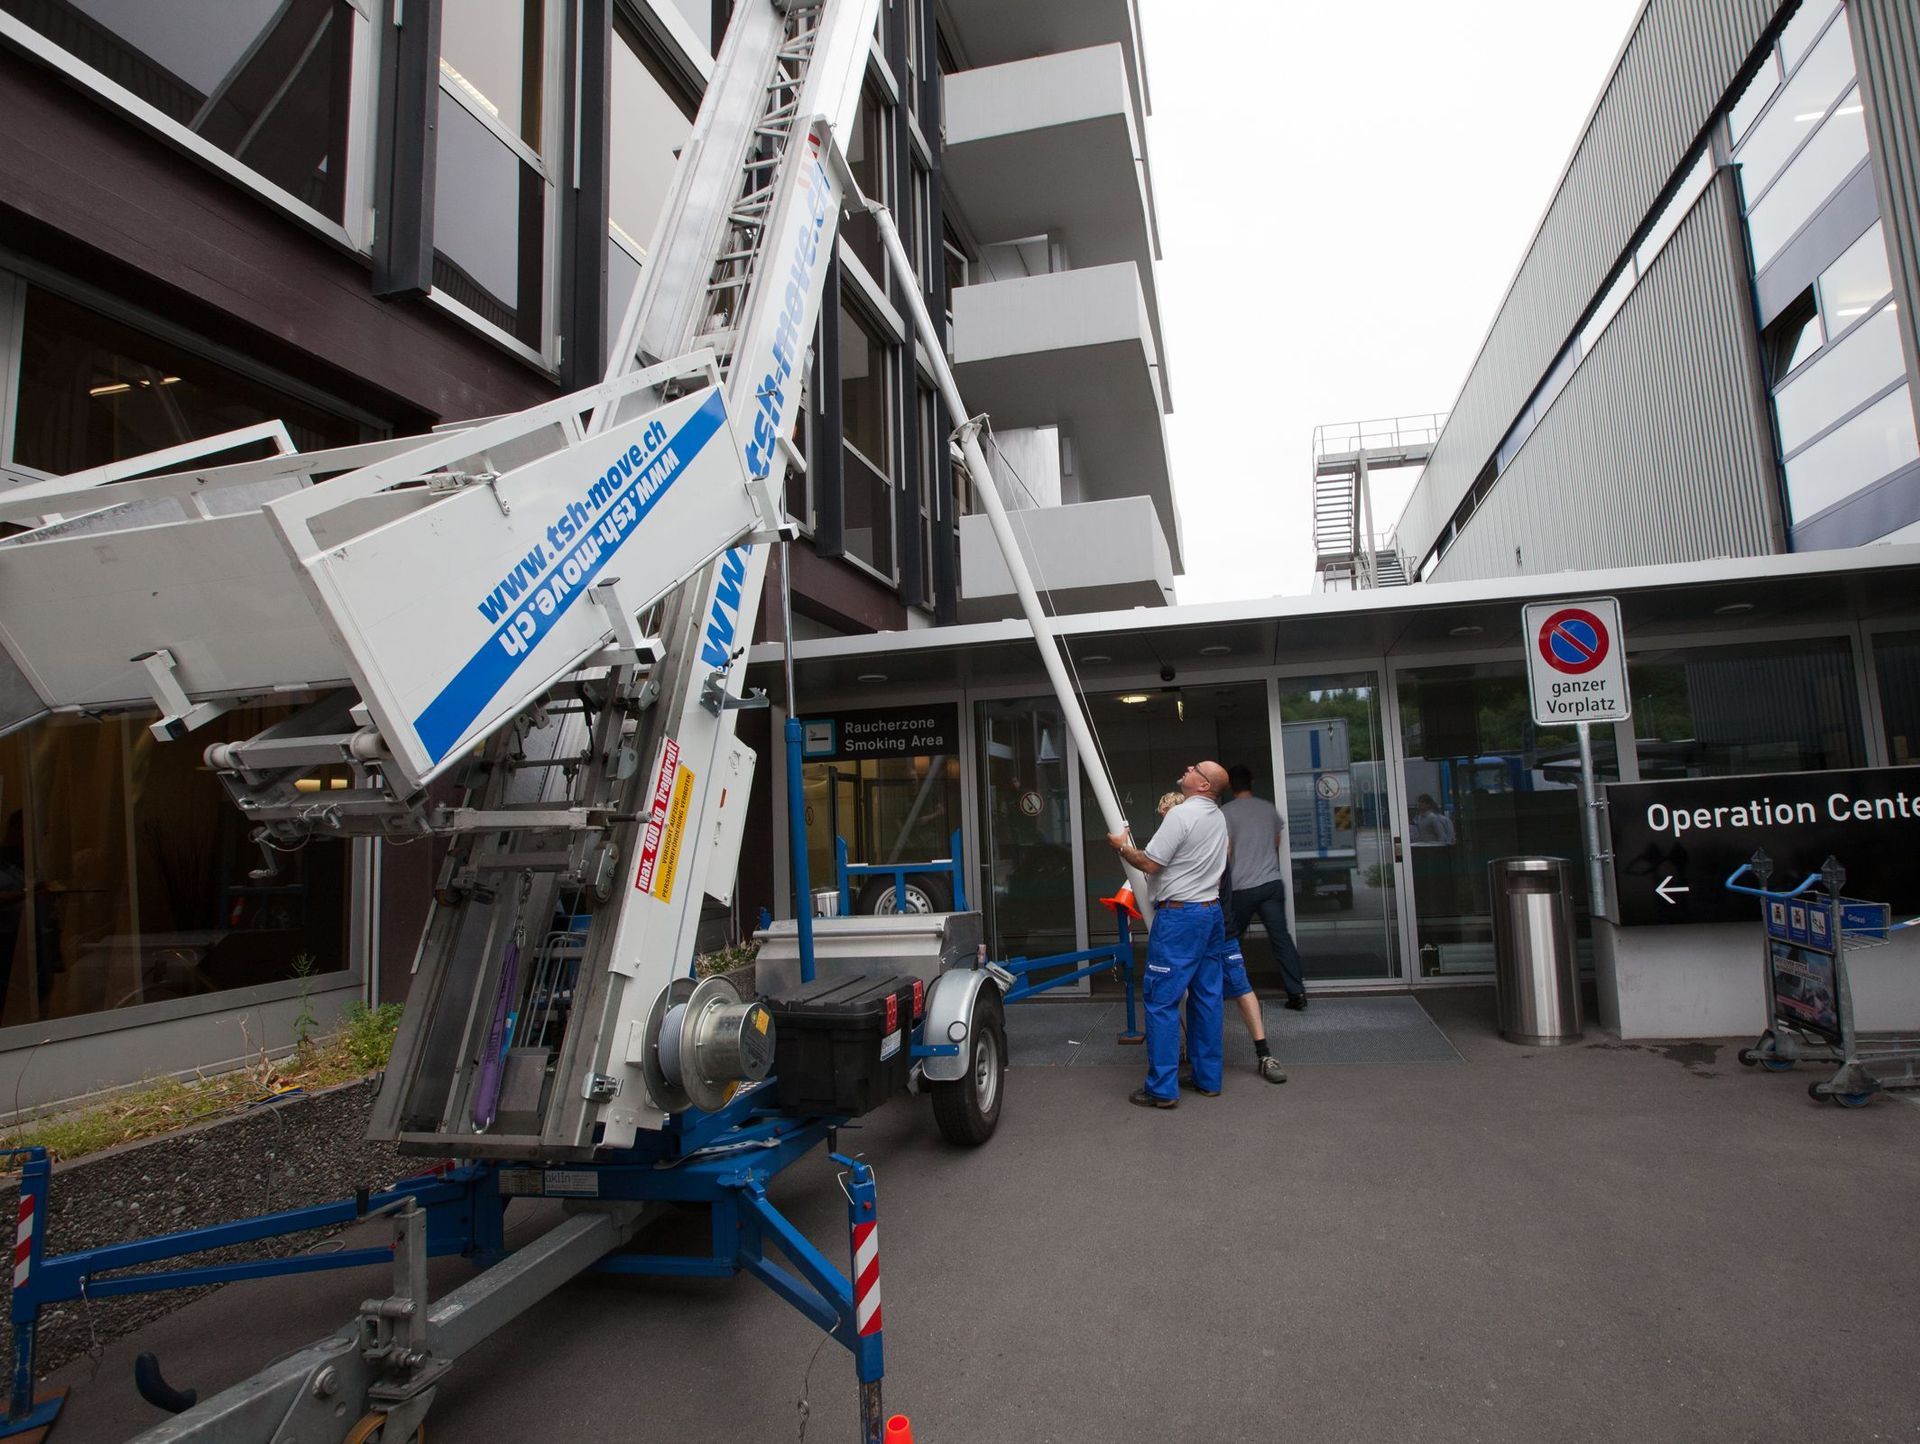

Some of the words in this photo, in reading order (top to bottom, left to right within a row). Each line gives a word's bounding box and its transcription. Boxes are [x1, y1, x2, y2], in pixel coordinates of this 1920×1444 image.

[477, 418, 668, 625] www.tsh-move.ch
[498, 446, 680, 657] www.tsh-move.ch
[1551, 680, 1606, 698] ganzer
[1546, 697, 1616, 716] Vorplatz
[844, 718, 936, 734] Raucherzone
[844, 737, 906, 751] Smoking
[911, 735, 944, 747] Area
[655, 738, 679, 804] Tragkraft
[680, 773, 692, 811] VERBOTEN
[654, 805, 666, 826] kg
[1646, 797, 1816, 838] Operation
[645, 820, 660, 854] 400
[661, 829, 674, 865] VORSICHT
[637, 857, 654, 891] max.
